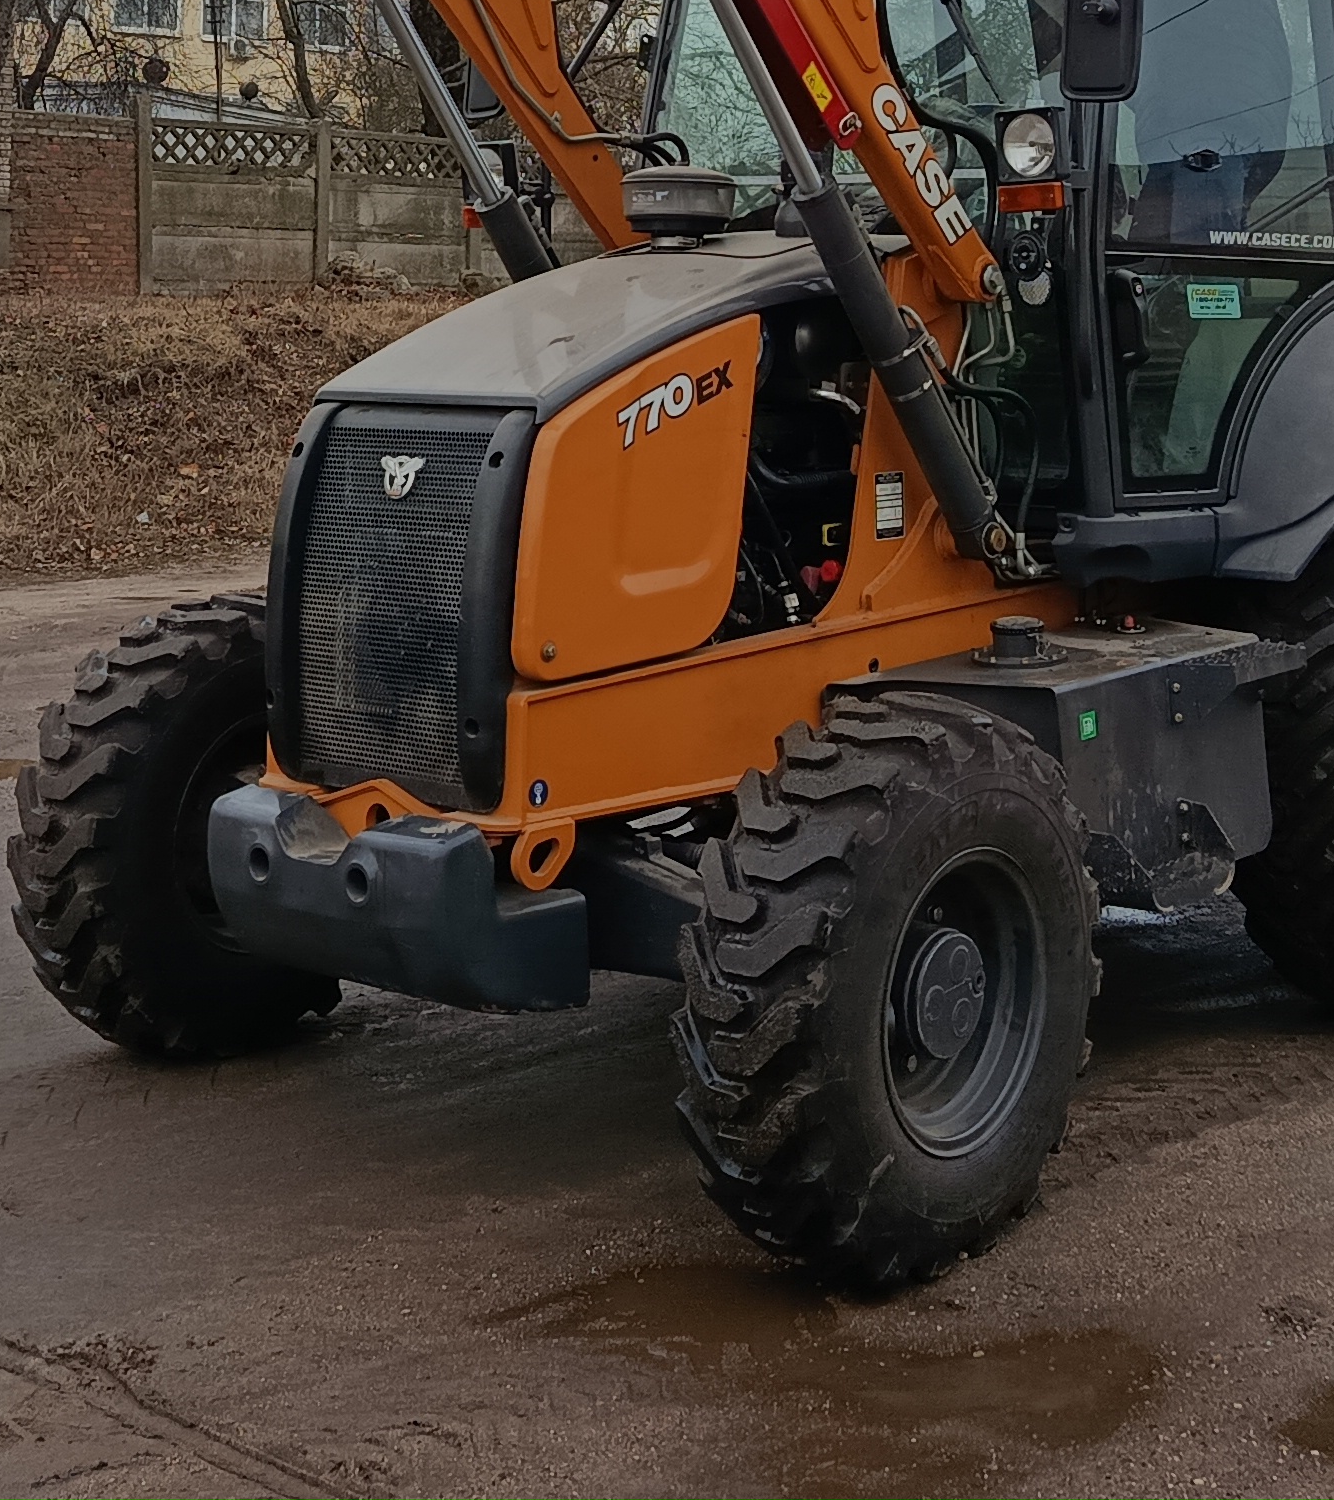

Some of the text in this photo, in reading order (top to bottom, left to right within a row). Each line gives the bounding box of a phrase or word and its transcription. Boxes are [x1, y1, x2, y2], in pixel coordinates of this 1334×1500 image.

[871, 83, 973, 246] CASE
[616, 359, 734, 451] 770 EX
